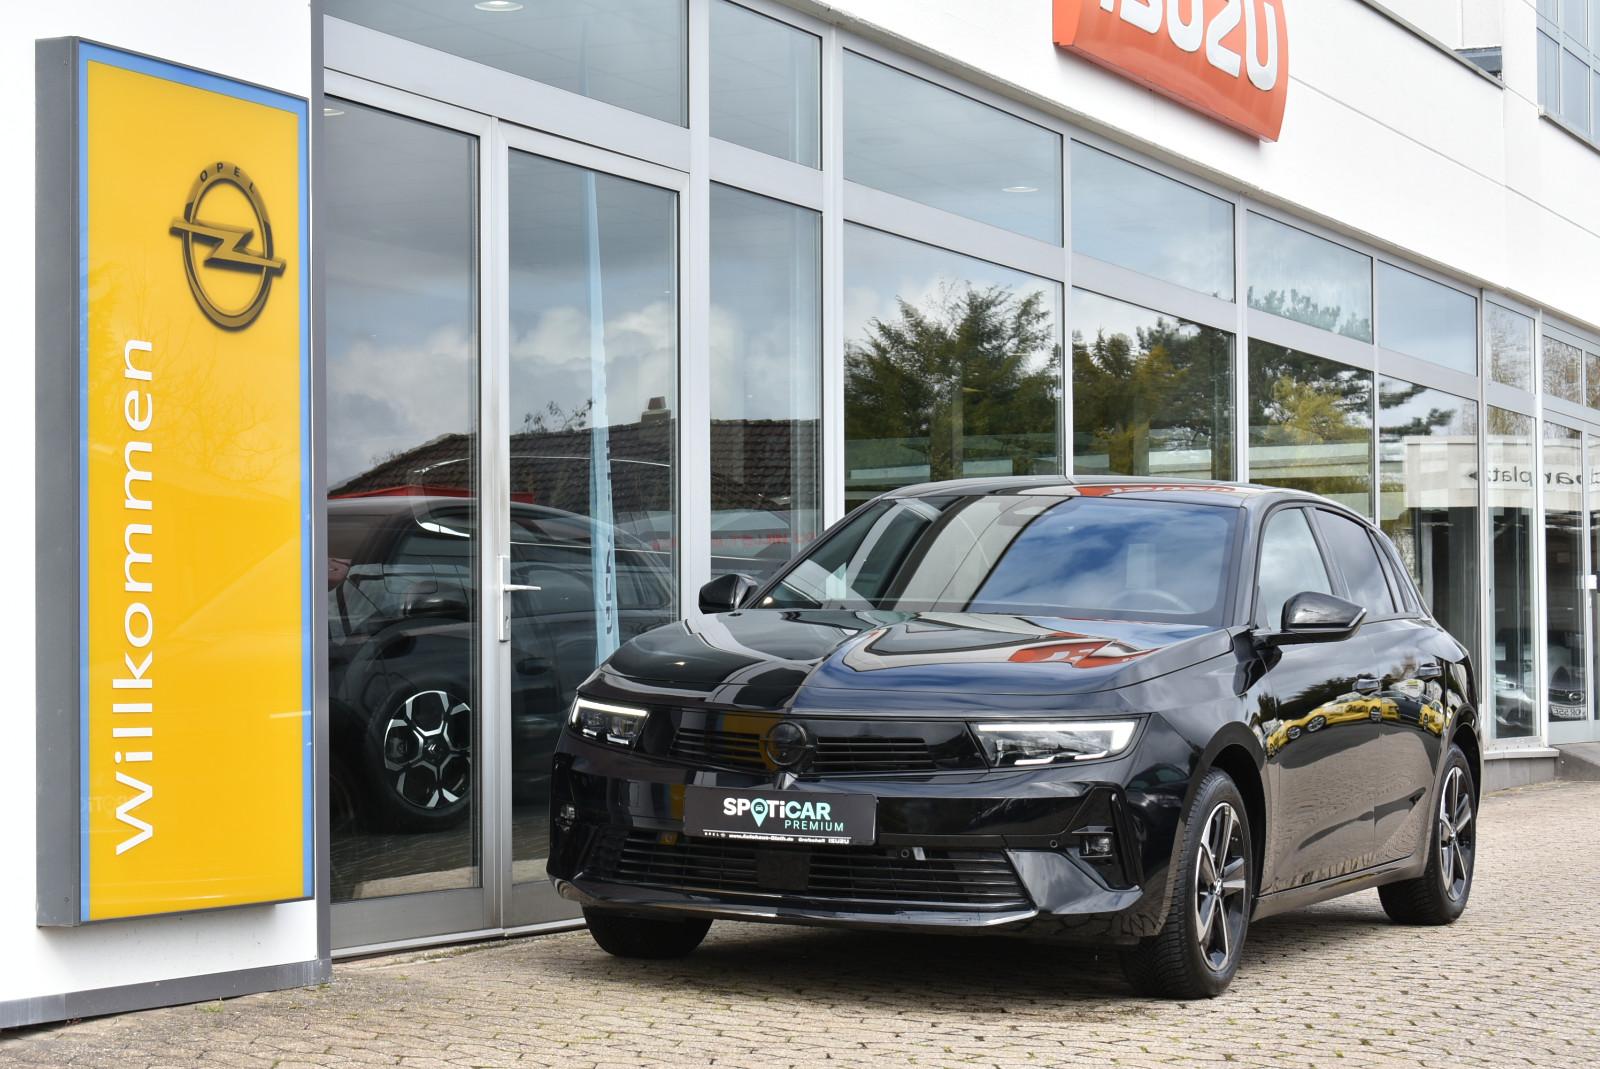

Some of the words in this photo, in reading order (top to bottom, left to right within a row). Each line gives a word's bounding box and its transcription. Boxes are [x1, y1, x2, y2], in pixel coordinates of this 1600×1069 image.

[1099, 0, 1278, 91] UZU
[200, 162, 254, 194] OPEL
[112, 338, 153, 855] Willkommen
[785, 819, 844, 832] PREMIUM
